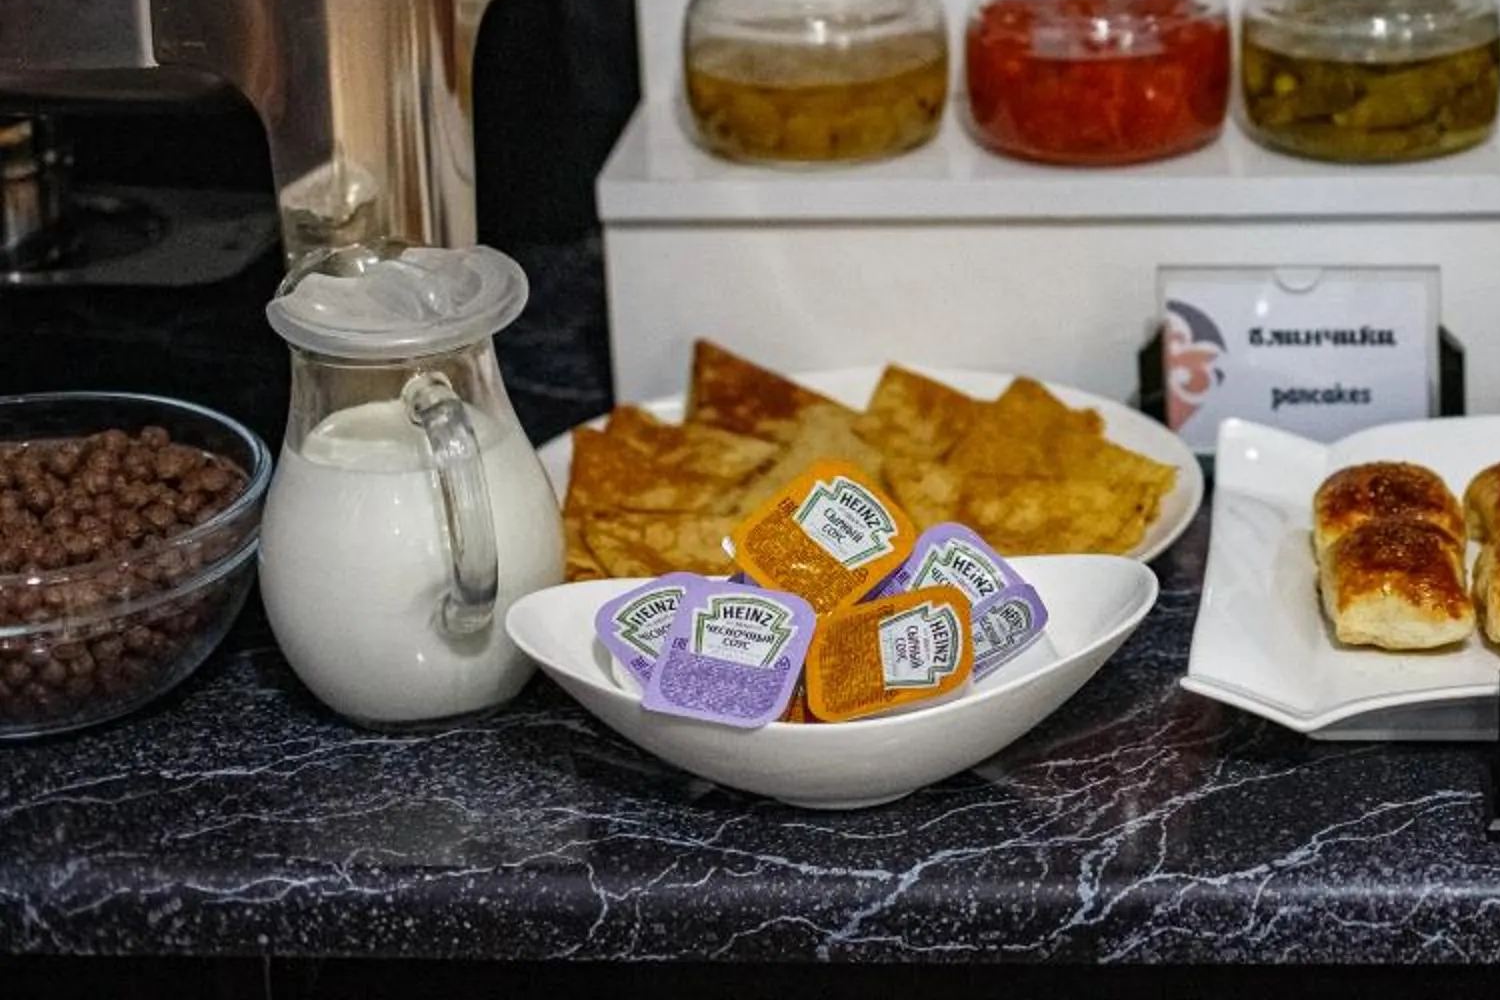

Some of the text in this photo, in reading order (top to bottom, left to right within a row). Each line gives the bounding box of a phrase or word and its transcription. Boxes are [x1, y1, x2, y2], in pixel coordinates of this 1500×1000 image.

[1248, 325, 1398, 347] блинчики
[1271, 383, 1371, 411] pancakes
[840, 493, 882, 528] HEINZ
[952, 556, 995, 597] HEINZ
[630, 598, 677, 626] HEINZ
[722, 605, 774, 627] HEINZ
[930, 619, 949, 664] HEINZ
